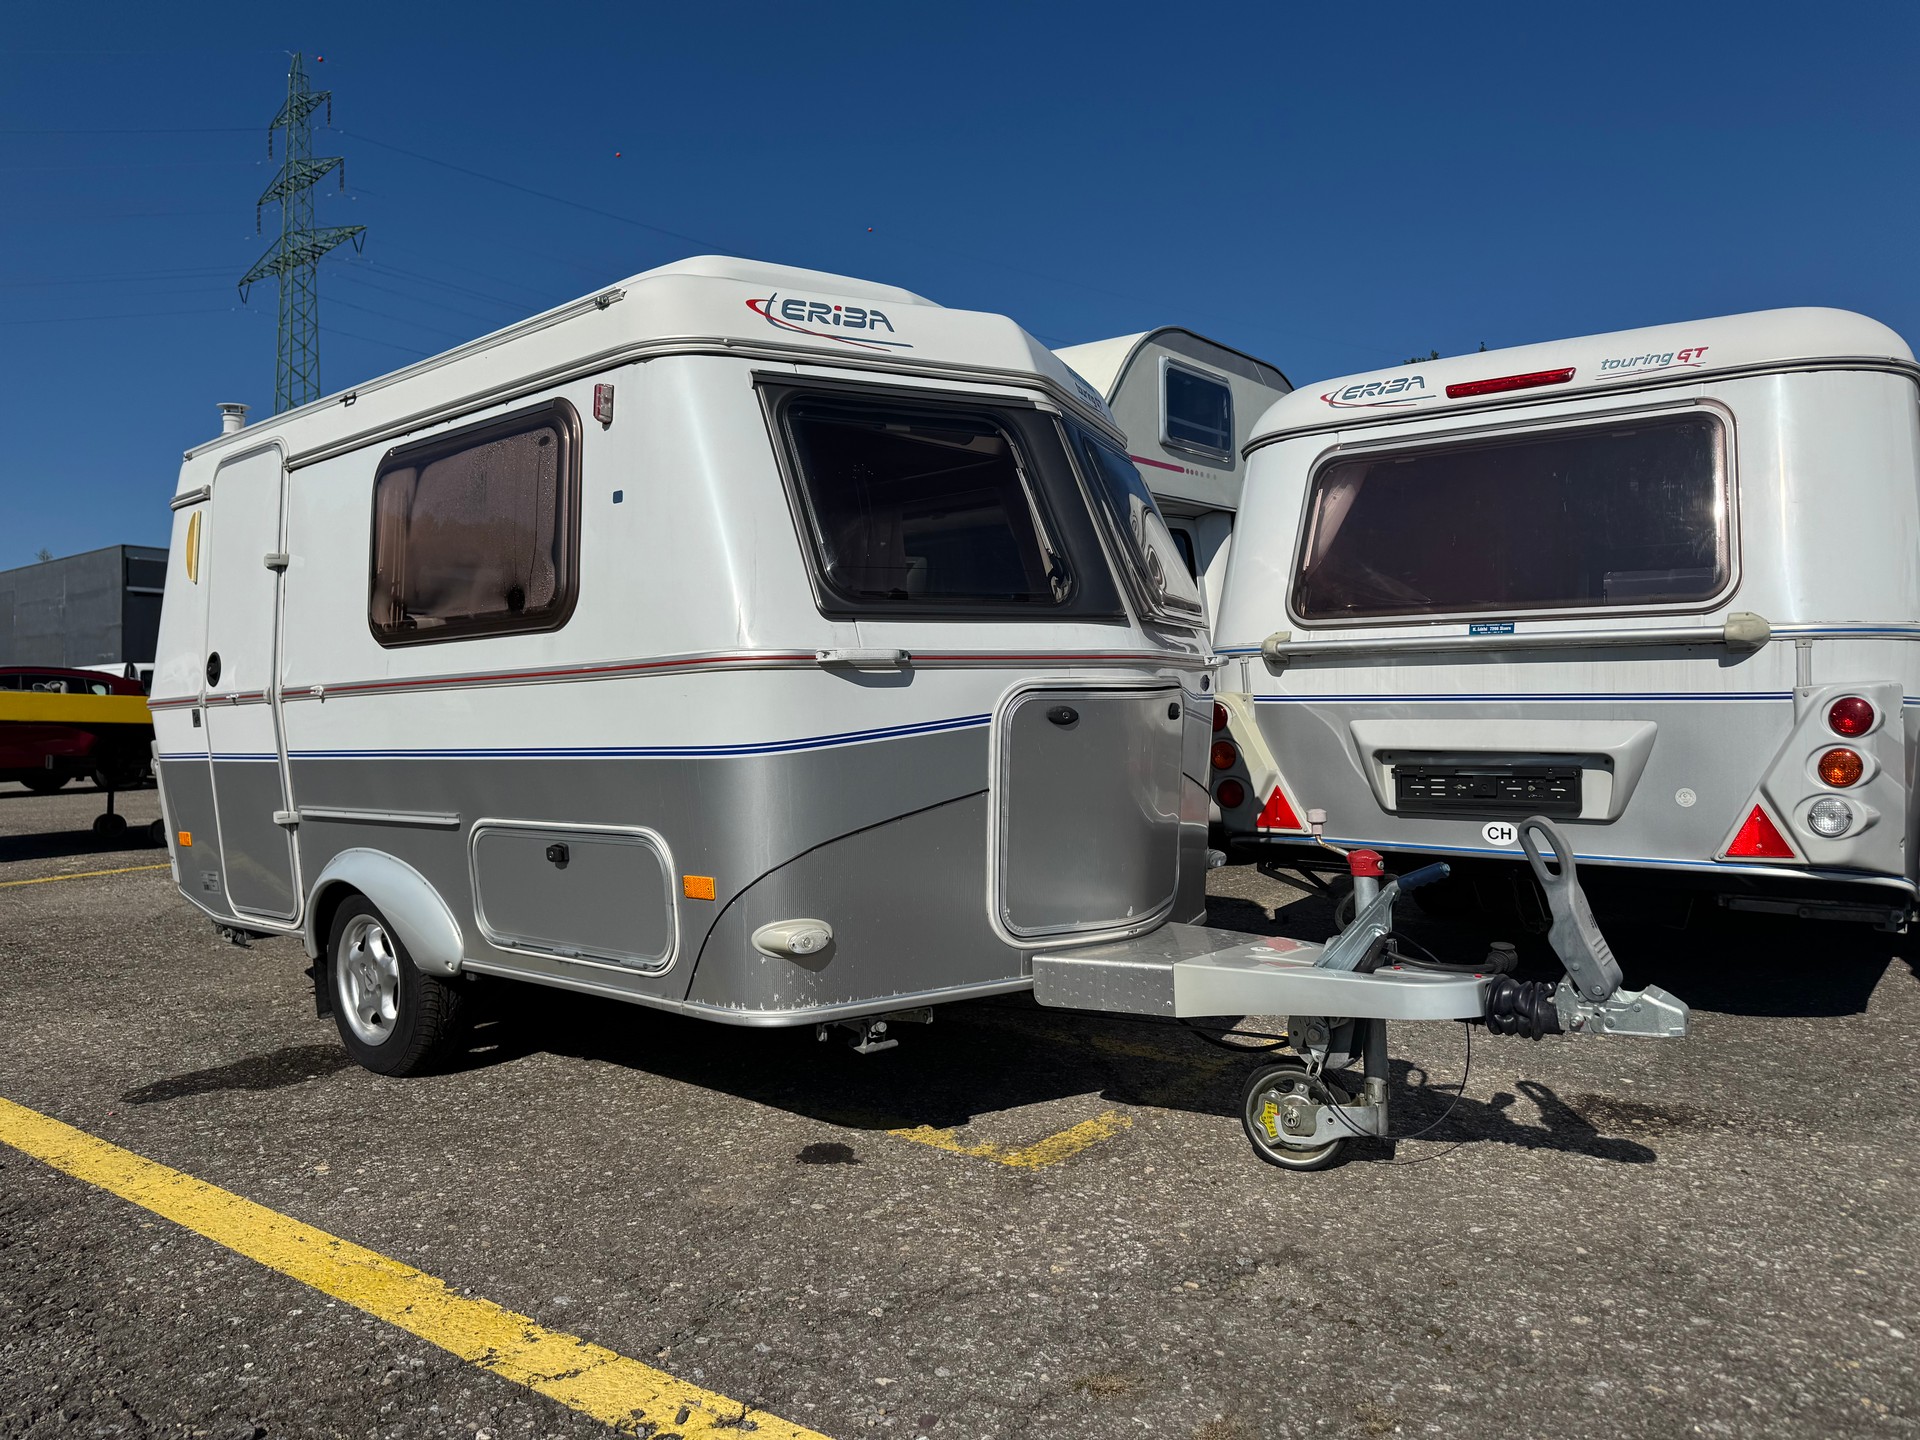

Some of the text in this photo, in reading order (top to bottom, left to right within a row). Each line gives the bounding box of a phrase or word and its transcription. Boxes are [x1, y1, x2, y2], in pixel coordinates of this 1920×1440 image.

[1601, 346, 1709, 370] touring GT
[1487, 826, 1512, 840] CH
